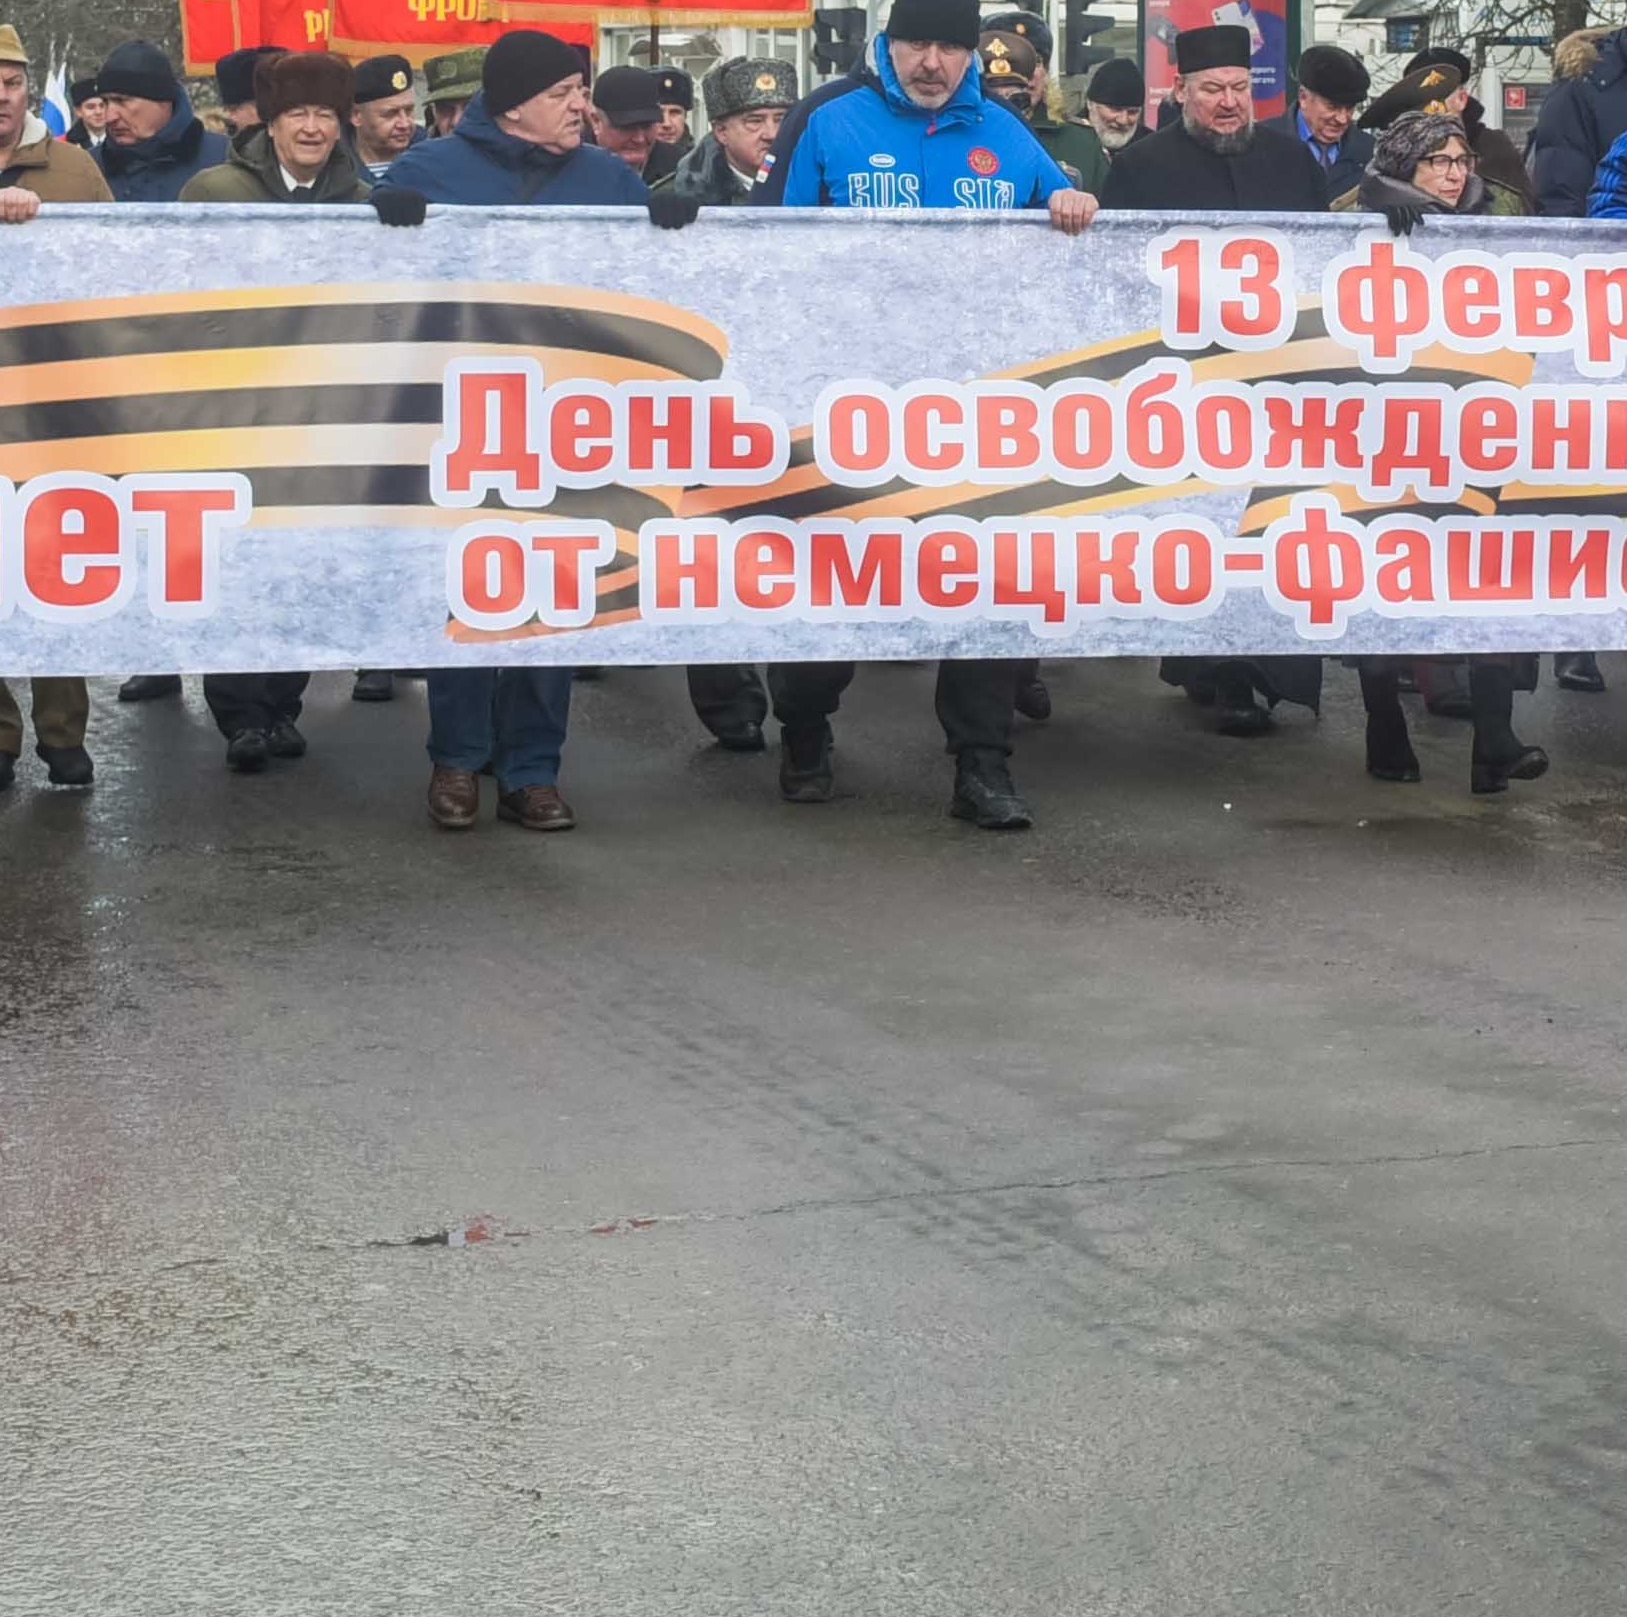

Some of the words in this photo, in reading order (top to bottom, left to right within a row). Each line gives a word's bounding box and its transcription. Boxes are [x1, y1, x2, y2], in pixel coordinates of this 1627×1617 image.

[1166, 241, 1278, 335] 13
[449, 373, 773, 490] День
[463, 538, 597, 612] от
